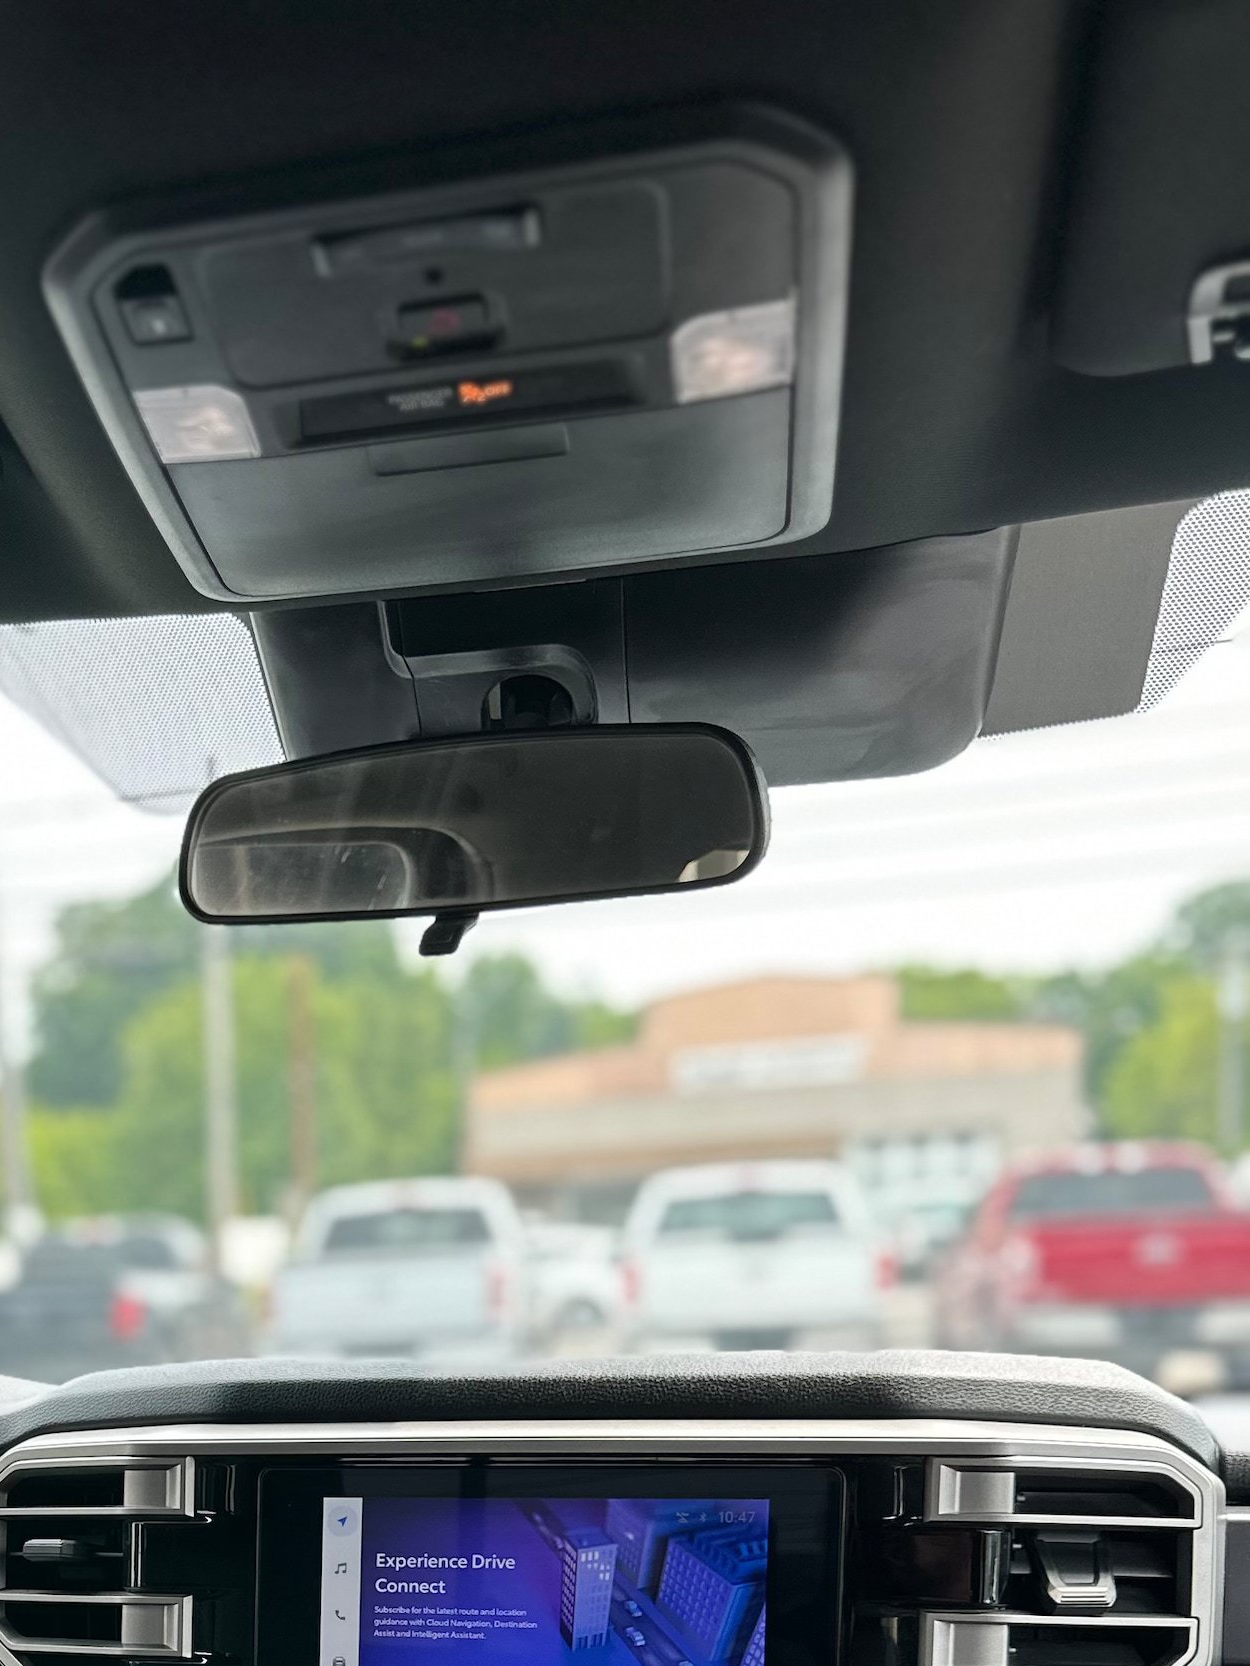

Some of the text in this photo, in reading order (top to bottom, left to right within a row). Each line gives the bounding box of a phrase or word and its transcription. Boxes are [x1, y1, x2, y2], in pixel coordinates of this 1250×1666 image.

[485, 381, 512, 397] OFF
[718, 1511, 756, 1524] 10:47
[375, 1552, 516, 1571] Experience Drive
[374, 1578, 446, 1594] Connect
[374, 1606, 410, 1614] Subscribe
[411, 1606, 422, 1614] for
[436, 1607, 458, 1615] latest
[459, 1608, 479, 1616] route
[480, 1608, 495, 1616] and
[496, 1608, 527, 1616] location
[373, 1618, 538, 1629] guidance with Cloud Navigation, Destination
[373, 1629, 486, 1640] Assist and Intelligent Assistant.
